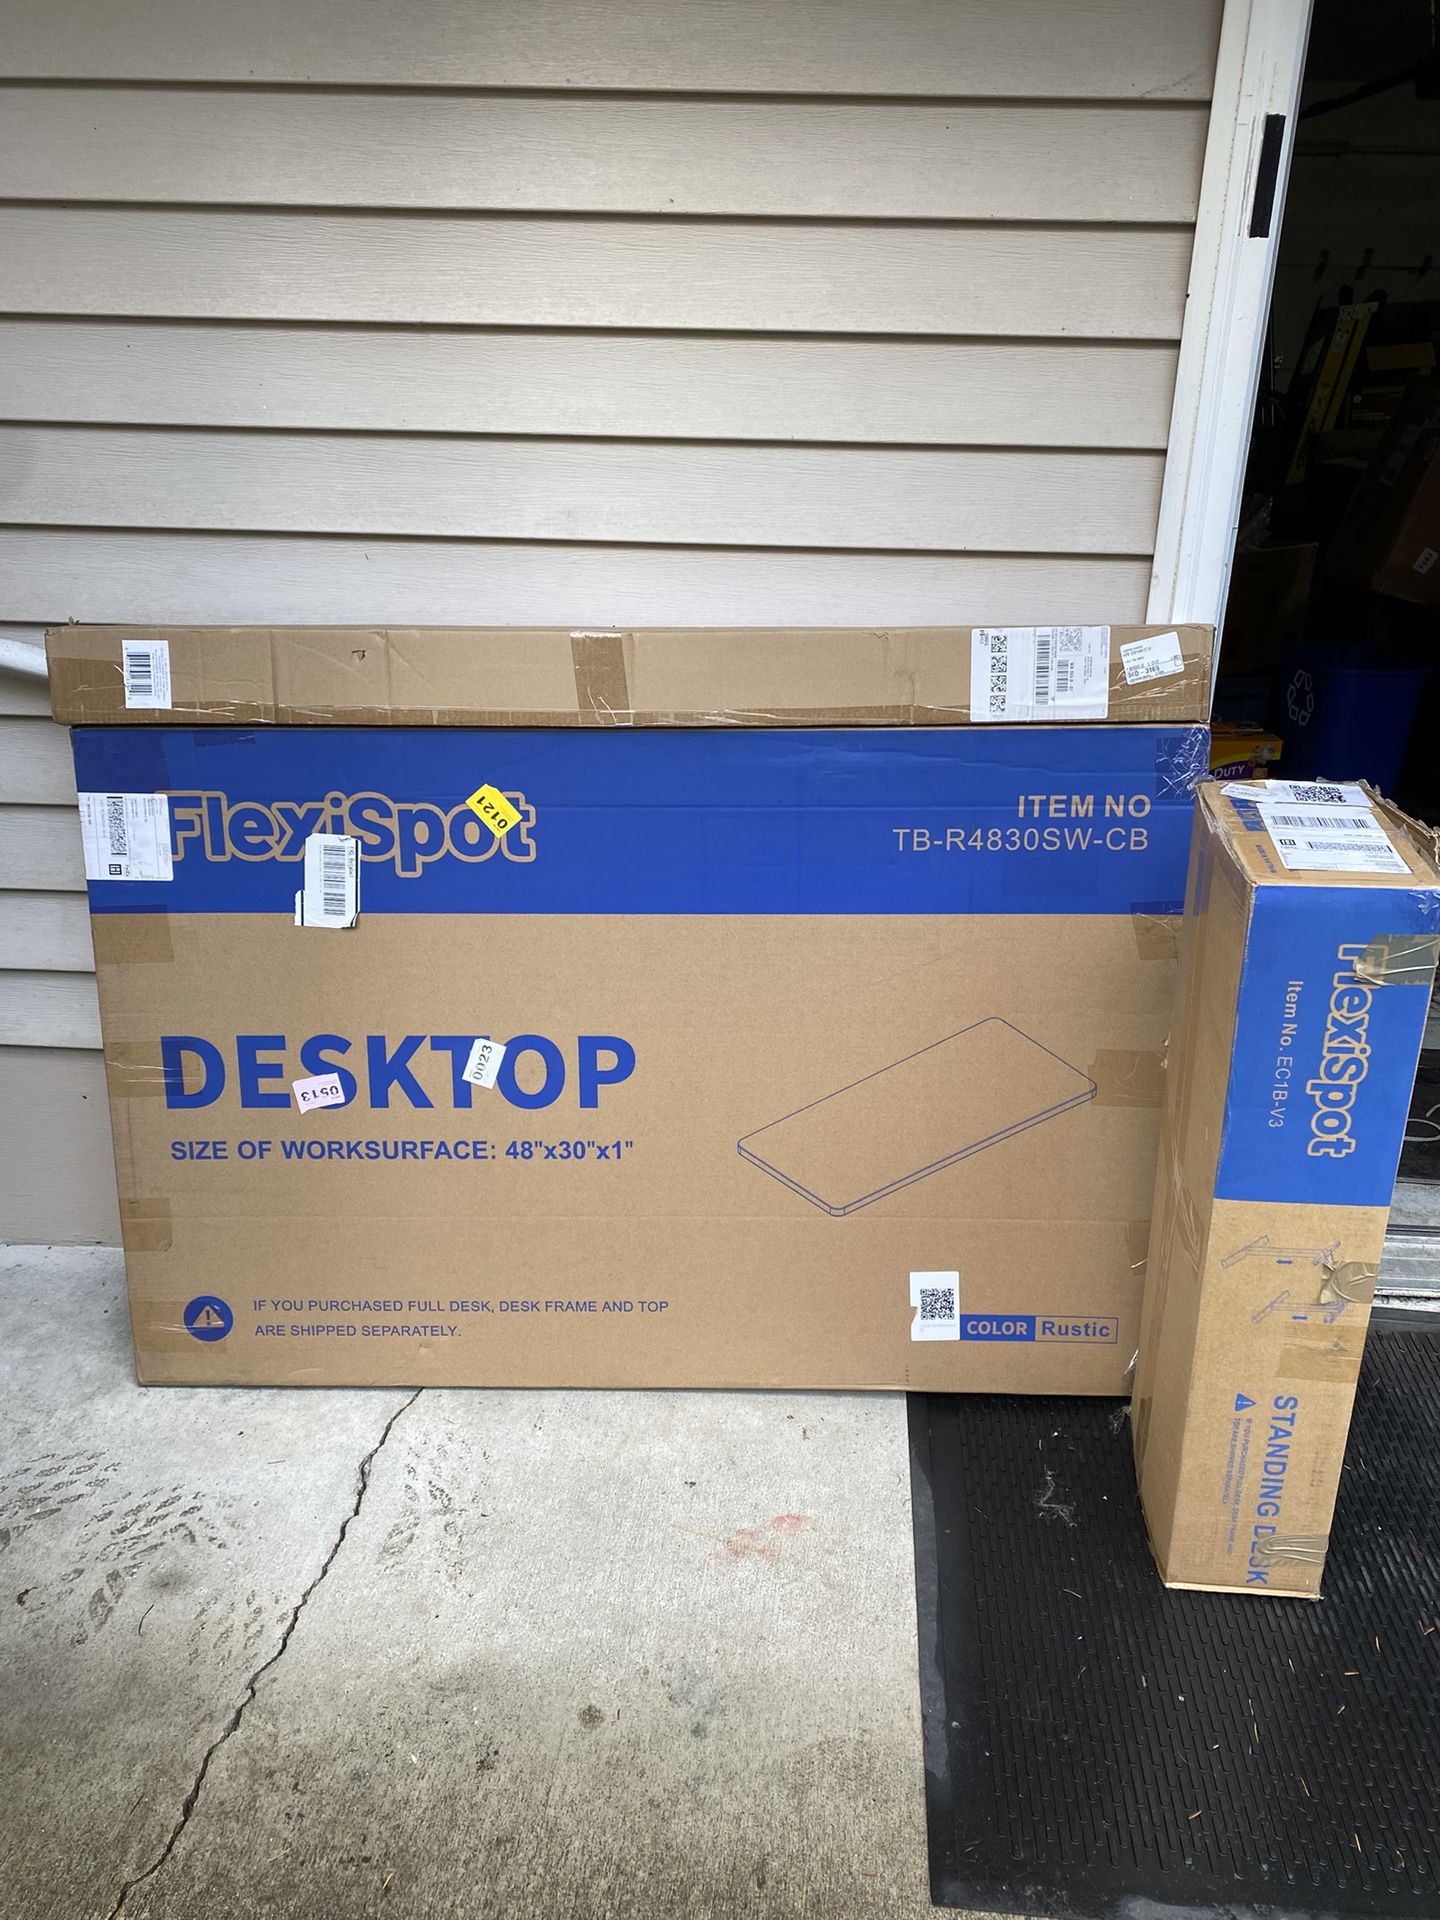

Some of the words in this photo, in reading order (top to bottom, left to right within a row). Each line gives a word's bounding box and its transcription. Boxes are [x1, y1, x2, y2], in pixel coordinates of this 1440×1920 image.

[477, 796, 507, 829] 0121
[1018, 795, 1094, 818] ITEM
[1105, 795, 1151, 818] NO
[157, 791, 536, 878] FlexiSpot
[892, 828, 1149, 851] TB-R4830SW-CB
[1283, 980, 1304, 1018] Item
[1279, 1023, 1297, 1051] No.
[160, 1034, 637, 1110] DESKTOP
[472, 1044, 493, 1080] 0023
[301, 1085, 339, 1102] 0513
[1268, 1057, 1293, 1128] EC1B-V3
[170, 1140, 229, 1161] SIZE
[237, 1140, 272, 1161] OF
[281, 1140, 496, 1161] WORKSURFACE:
[505, 1140, 633, 1161] 48"x30"x1"
[253, 1300, 266, 1311] IF
[271, 1300, 304, 1312] YOU
[308, 1300, 403, 1312] PURCHASED
[408, 1301, 445, 1312] FULL
[450, 1301, 495, 1313] DESK,
[500, 1301, 541, 1312] DESK
[545, 1301, 598, 1312] FRAME
[602, 1301, 634, 1312] AND
[639, 1301, 669, 1312] TOP
[255, 1325, 286, 1336] ARE
[290, 1325, 356, 1336] SHIPPED
[361, 1325, 462, 1337] SEPARATELY.
[966, 1320, 1027, 1335] COLOR
[1042, 1321, 1110, 1337] Rustic
[1256, 1395, 1299, 1518] STANDING
[1246, 1525, 1277, 1585] DSK
